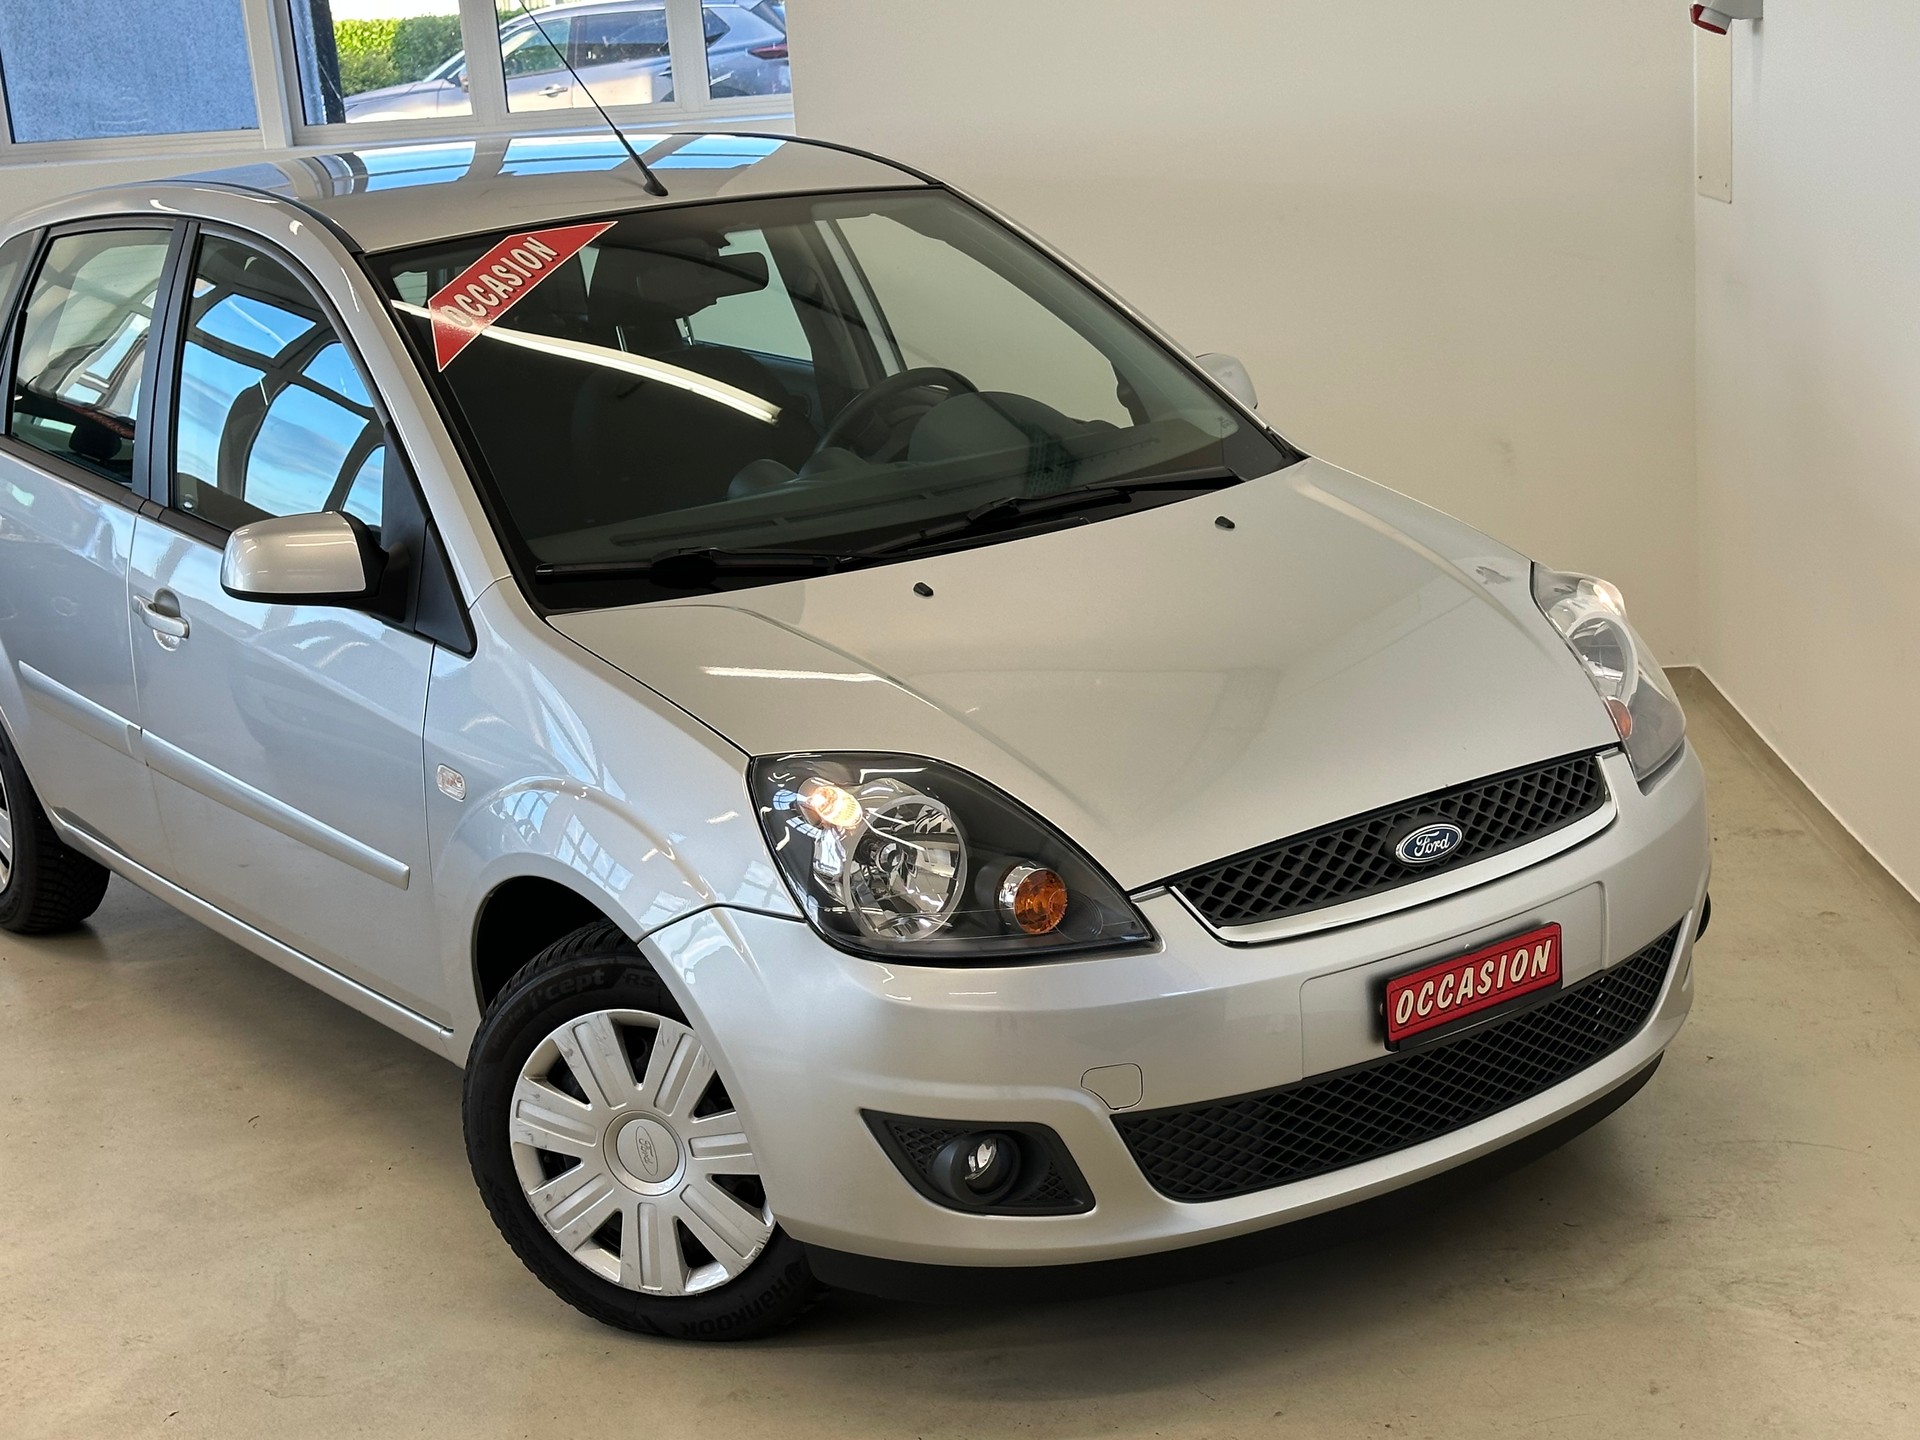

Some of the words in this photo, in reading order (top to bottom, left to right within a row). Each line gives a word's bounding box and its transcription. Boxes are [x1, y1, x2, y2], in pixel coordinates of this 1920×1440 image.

[440, 236, 559, 328] OCCASION
[1414, 830, 1450, 857] Ford
[1395, 939, 1552, 1025] OCCASION
